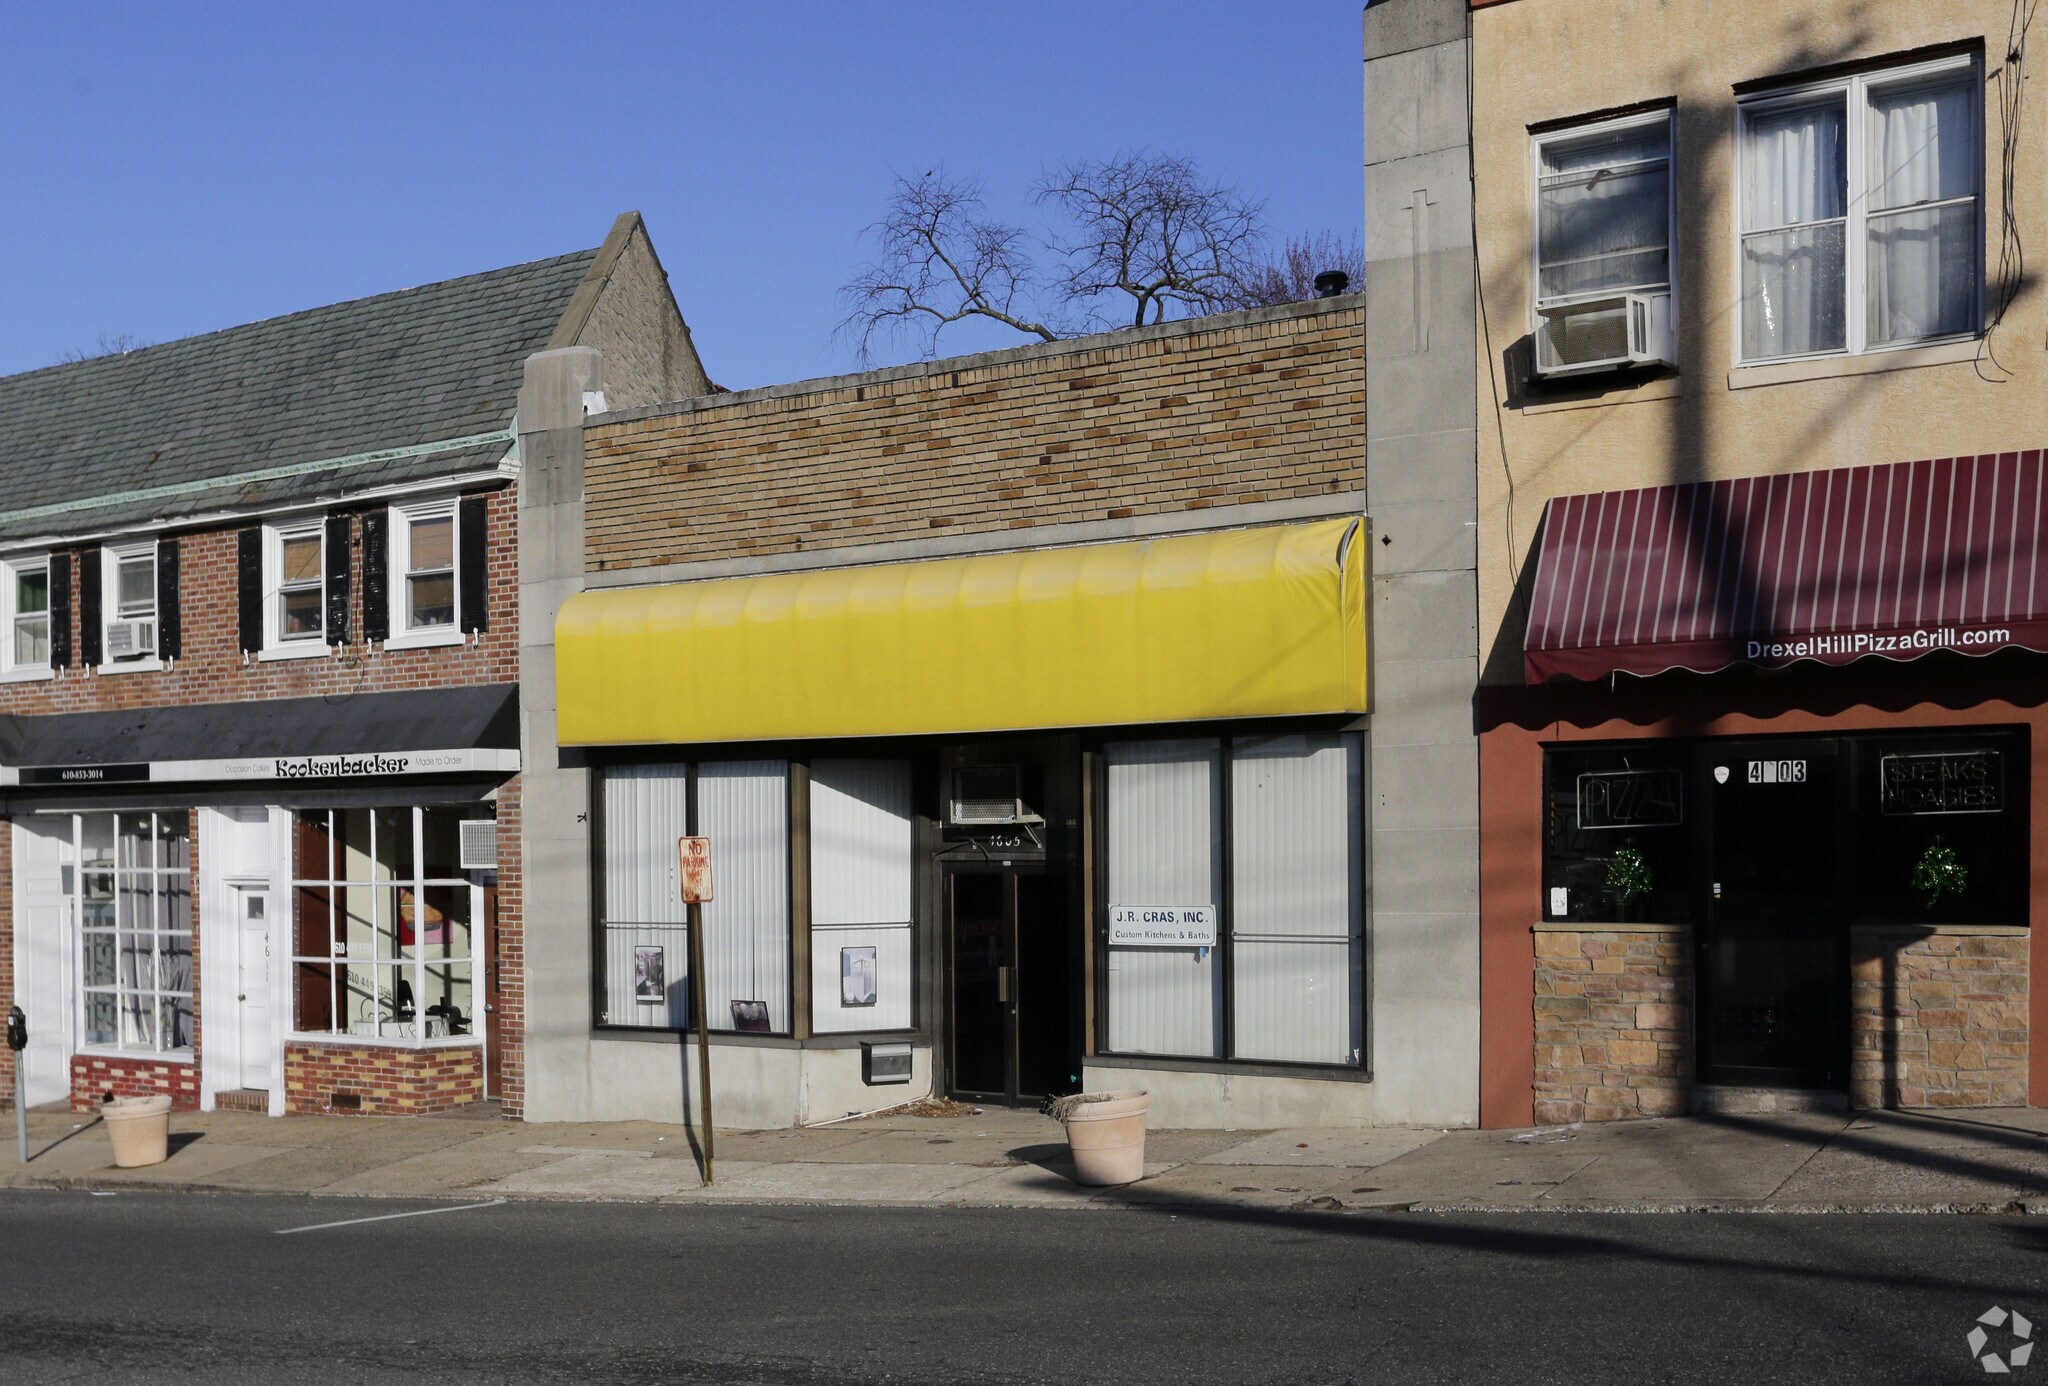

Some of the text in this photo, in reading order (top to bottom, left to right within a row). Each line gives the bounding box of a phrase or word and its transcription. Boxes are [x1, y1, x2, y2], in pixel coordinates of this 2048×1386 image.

[1747, 628, 2011, 659] DrexelHillPizzaGrill.com
[274, 755, 409, 778] Kookenbacker
[415, 756, 462, 767] Made to Order
[62, 769, 103, 780] 610-853-3014
[688, 843, 702, 855] NO
[682, 856, 710, 868] PARKING
[1116, 911, 1209, 925] J.R. CRAS, INC.
[1115, 930, 1210, 940] Custom Kitchens & Baths
